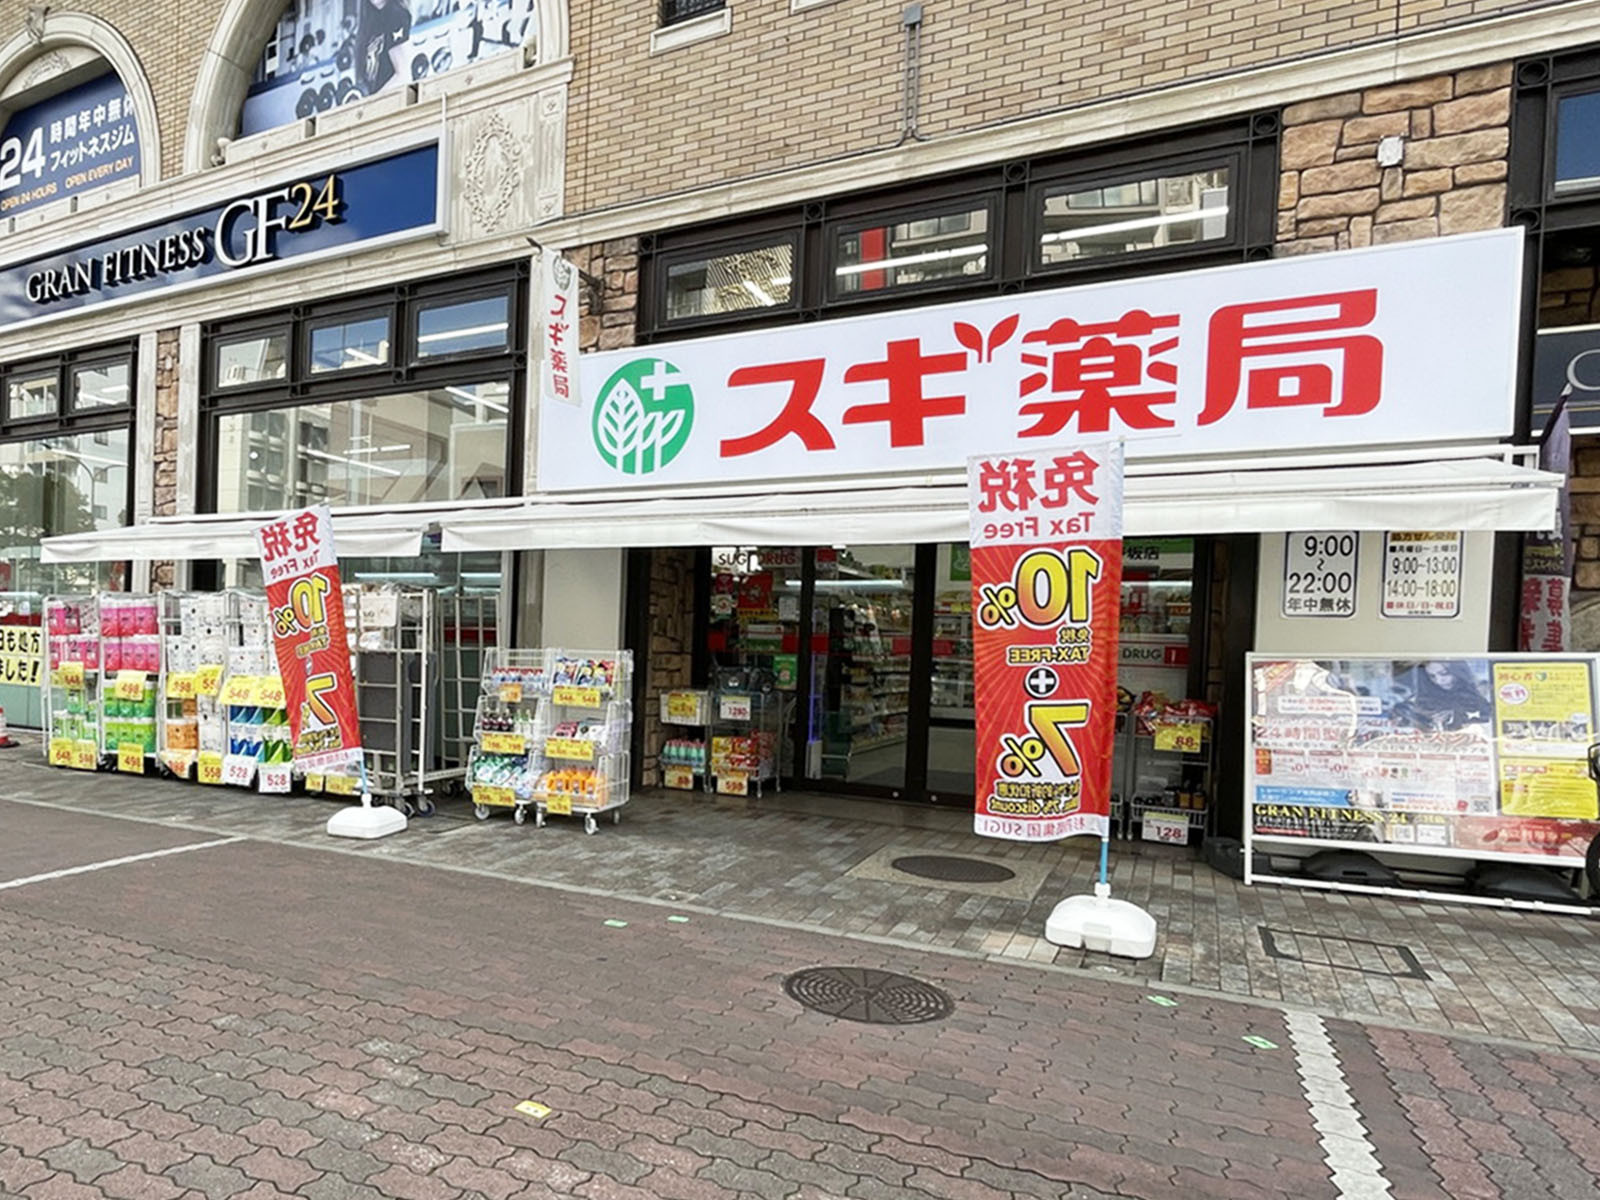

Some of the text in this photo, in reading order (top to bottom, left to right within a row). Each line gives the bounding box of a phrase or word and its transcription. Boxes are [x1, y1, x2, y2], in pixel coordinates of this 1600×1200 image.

[50, 93, 134, 144] 時間年中無休
[50, 124, 136, 172] フィットネスジム
[0, 127, 46, 192] 24
[65, 155, 134, 189] OPEN EVERY DAY
[26, 257, 92, 302] GRAN
[103, 225, 206, 283] FITNESS
[720, 288, 1384, 458] スギ薬局
[1304, 535, 1354, 557] 9:00
[1288, 572, 1352, 594] 22:00
[1287, 597, 1352, 612] 年中無休
[1123, 648, 1162, 660] DRUG
[1175, 736, 1194, 747] 88
[267, 774, 287, 787] 528
[1255, 804, 1304, 817] GRAN
[1309, 806, 1385, 823] FITNESS
[1156, 825, 1182, 838] 128
